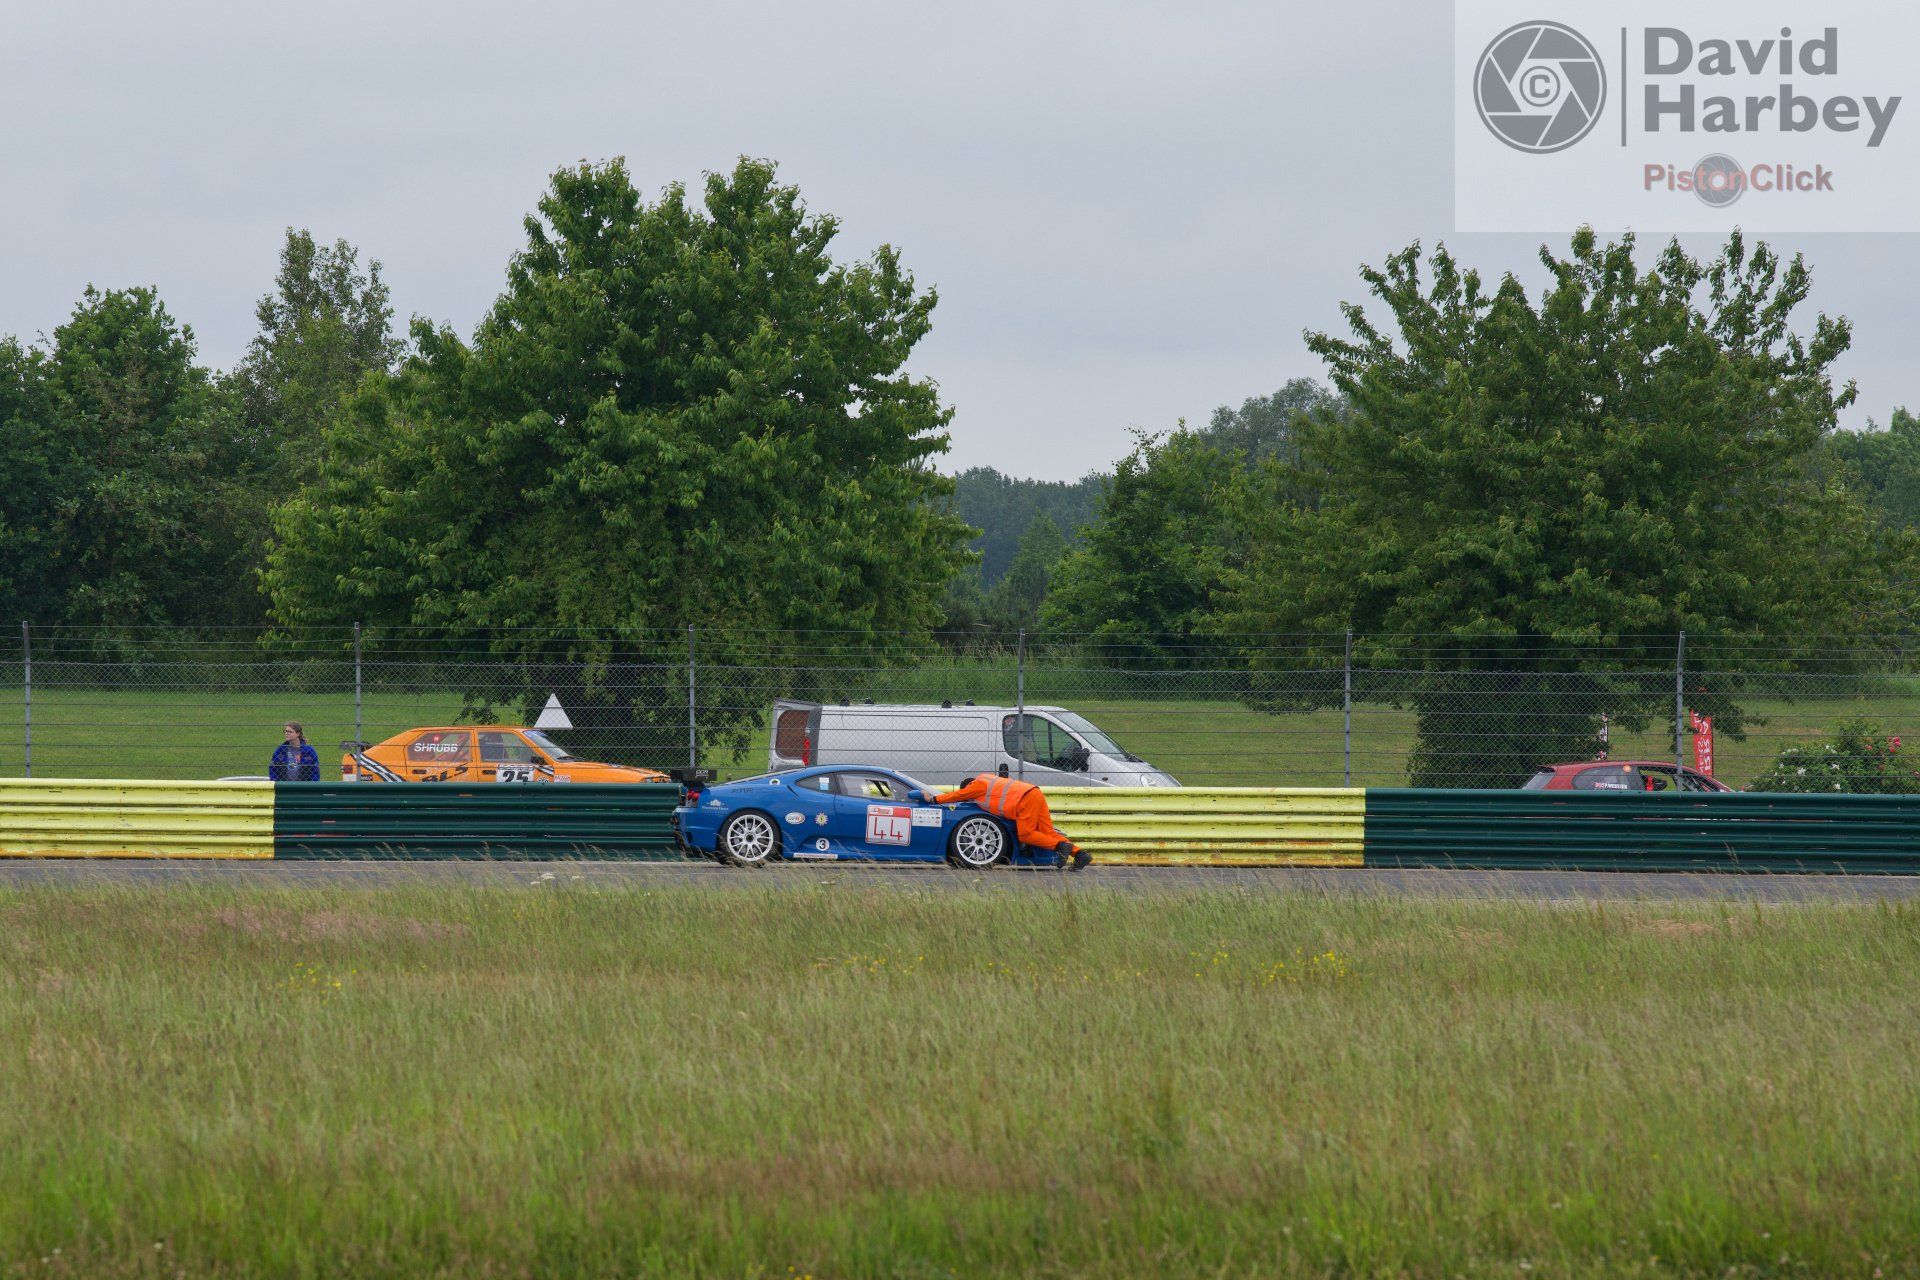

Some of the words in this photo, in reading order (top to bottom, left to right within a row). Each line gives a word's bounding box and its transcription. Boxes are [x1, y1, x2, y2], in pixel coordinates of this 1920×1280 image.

[414, 742, 458, 752] SHRUBB
[502, 770, 530, 782] 25
[874, 816, 903, 840] 44
[818, 839, 826, 849] 3
